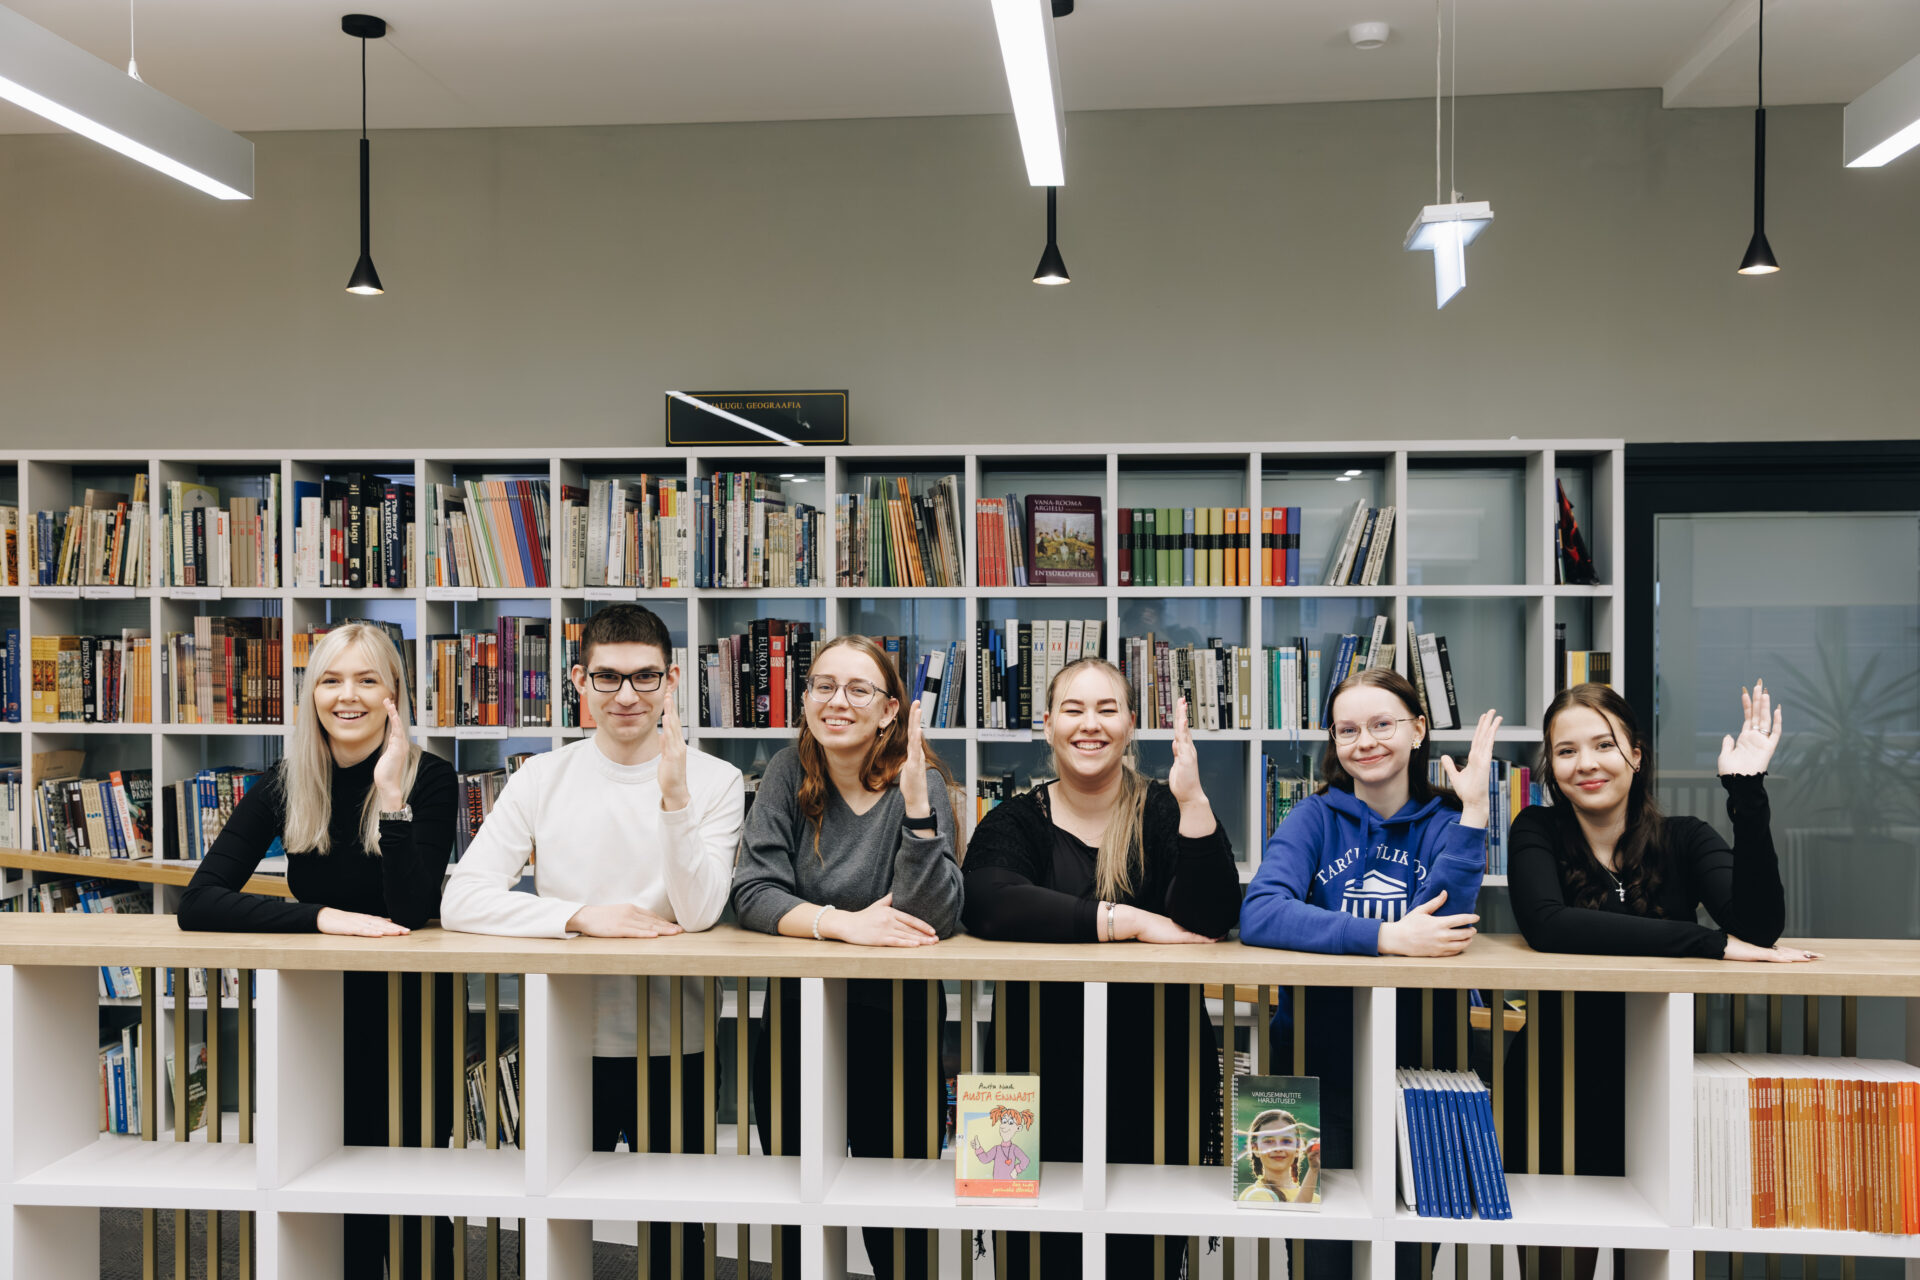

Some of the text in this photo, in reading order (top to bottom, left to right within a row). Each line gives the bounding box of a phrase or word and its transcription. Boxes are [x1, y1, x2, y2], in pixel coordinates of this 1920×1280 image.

[746, 401, 802, 410] GEOGRAAFIA
[1034, 499, 1083, 507] VANA-ROOMA
[384, 500, 392, 545] AMERICA
[1034, 569, 1096, 578] ENTSÜKLOPEEDIA
[758, 636, 768, 690] EUROOPA
[1251, 1091, 1302, 1099] VAIKUSEMINUTITE
[1257, 1097, 1296, 1105] HARJUTUSED
